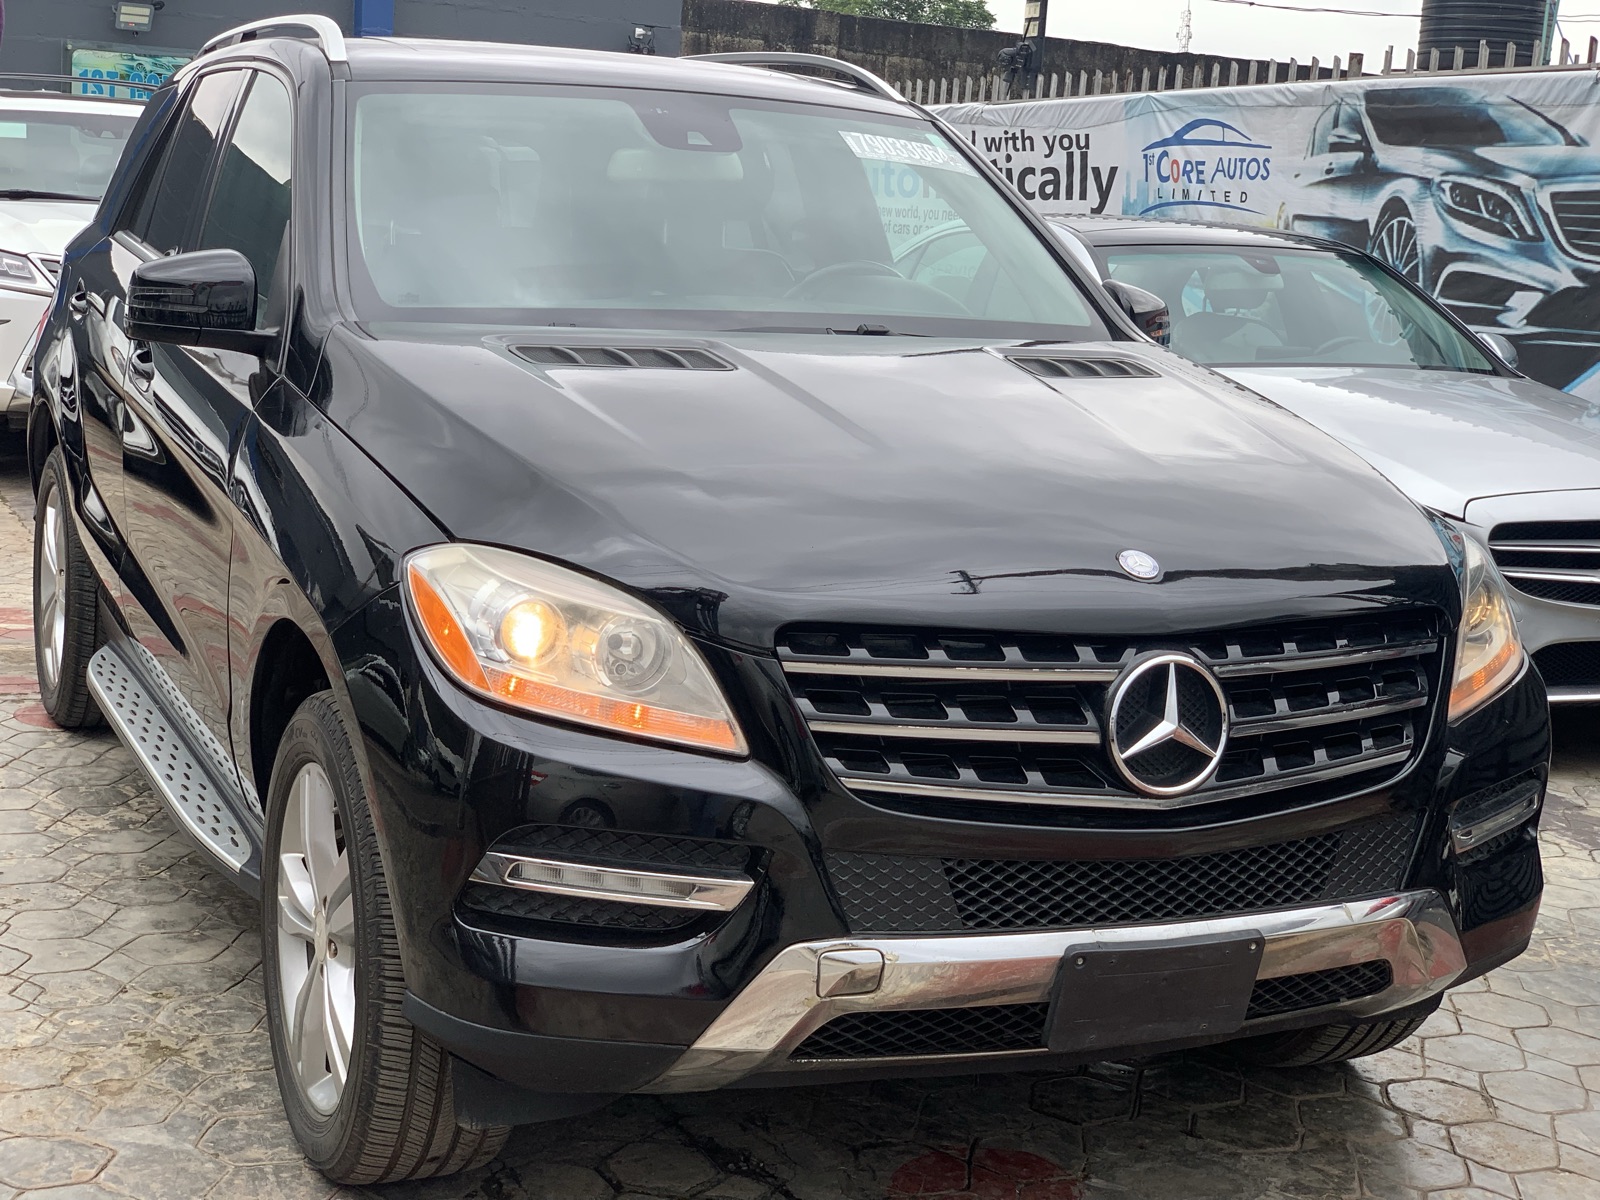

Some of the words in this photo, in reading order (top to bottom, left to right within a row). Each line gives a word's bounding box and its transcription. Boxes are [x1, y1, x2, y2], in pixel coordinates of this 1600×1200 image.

[983, 128, 1034, 152] with
[1043, 133, 1090, 158] you
[1210, 157, 1271, 183] AUTOS
[1157, 188, 1248, 203] LIMITED
[923, 209, 940, 222] you
[893, 223, 910, 235] cars
